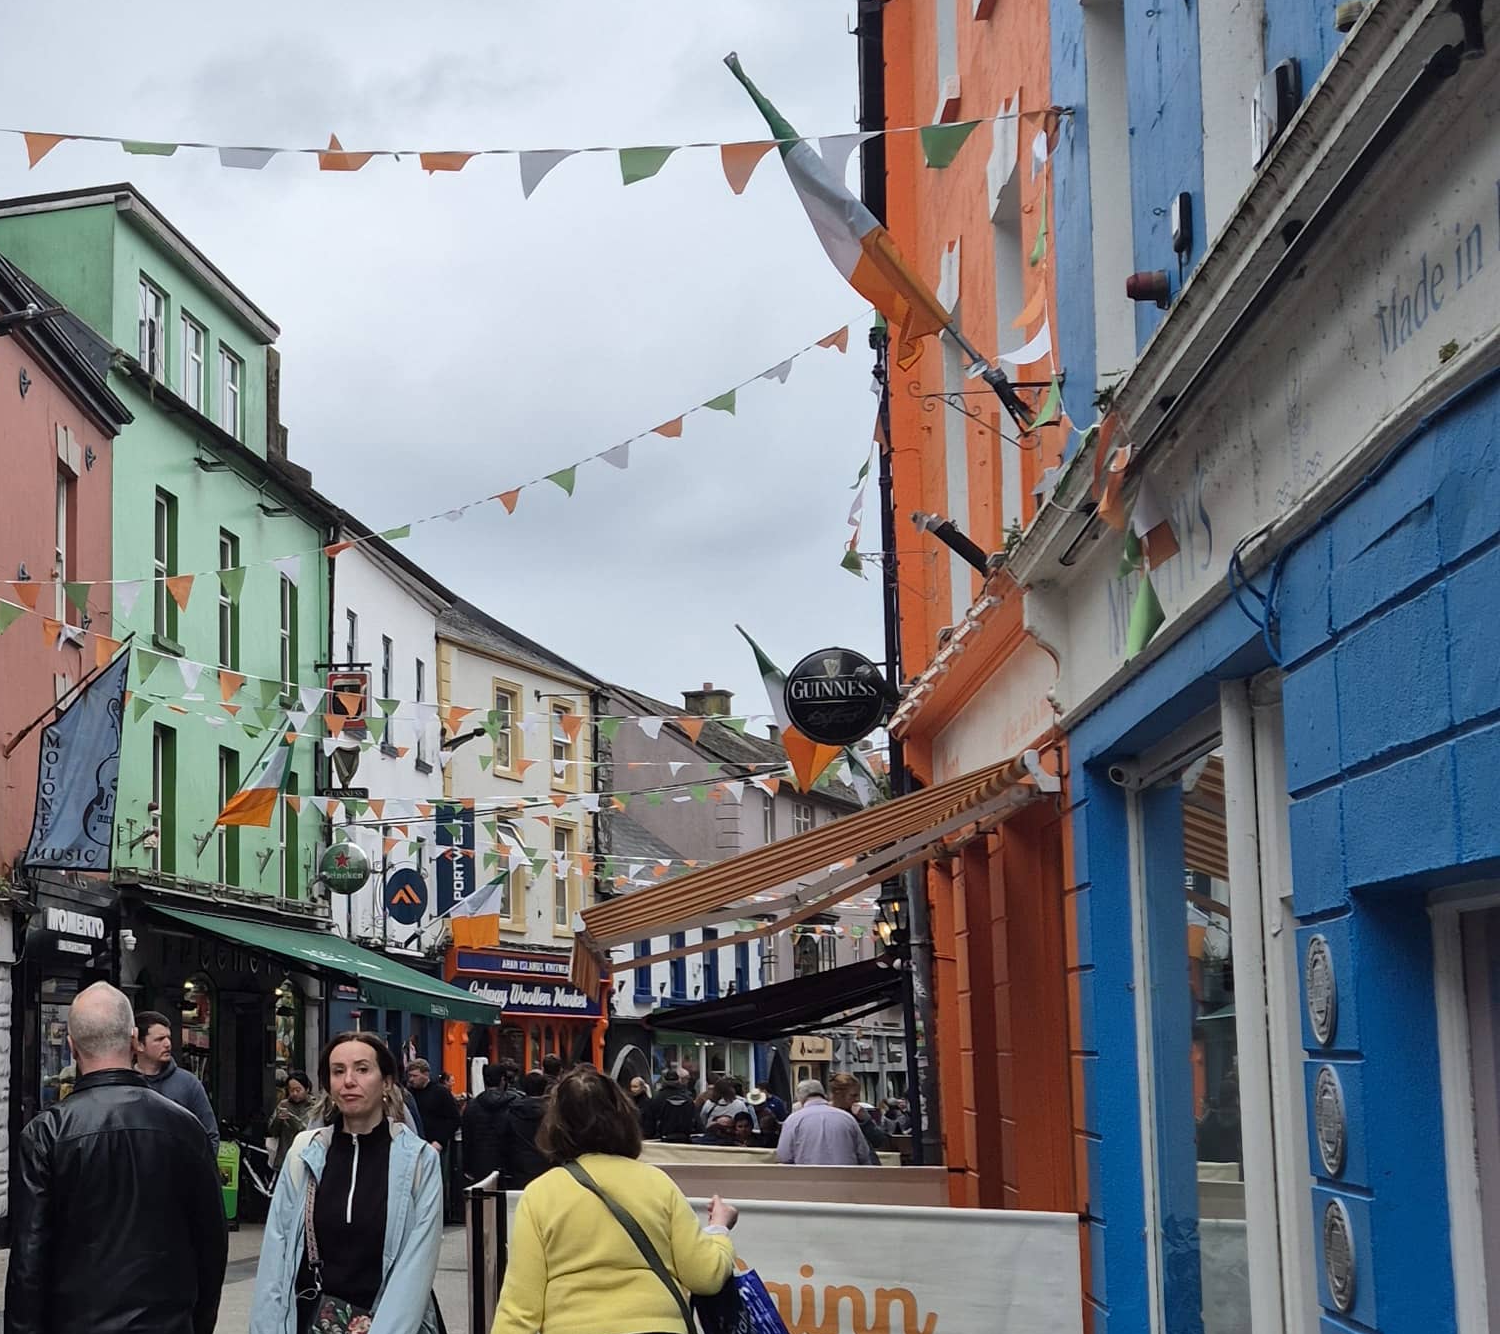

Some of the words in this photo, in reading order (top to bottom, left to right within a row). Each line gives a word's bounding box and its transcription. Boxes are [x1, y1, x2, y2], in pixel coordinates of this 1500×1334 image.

[1374, 250, 1446, 357] Made
[1455, 222, 1484, 292] in
[790, 680, 878, 699] GUINNESS
[37, 733, 61, 841] MOLONEY
[32, 847, 95, 863] MUSIC
[509, 983, 551, 1006] Woollen
[553, 986, 588, 1008] Market
